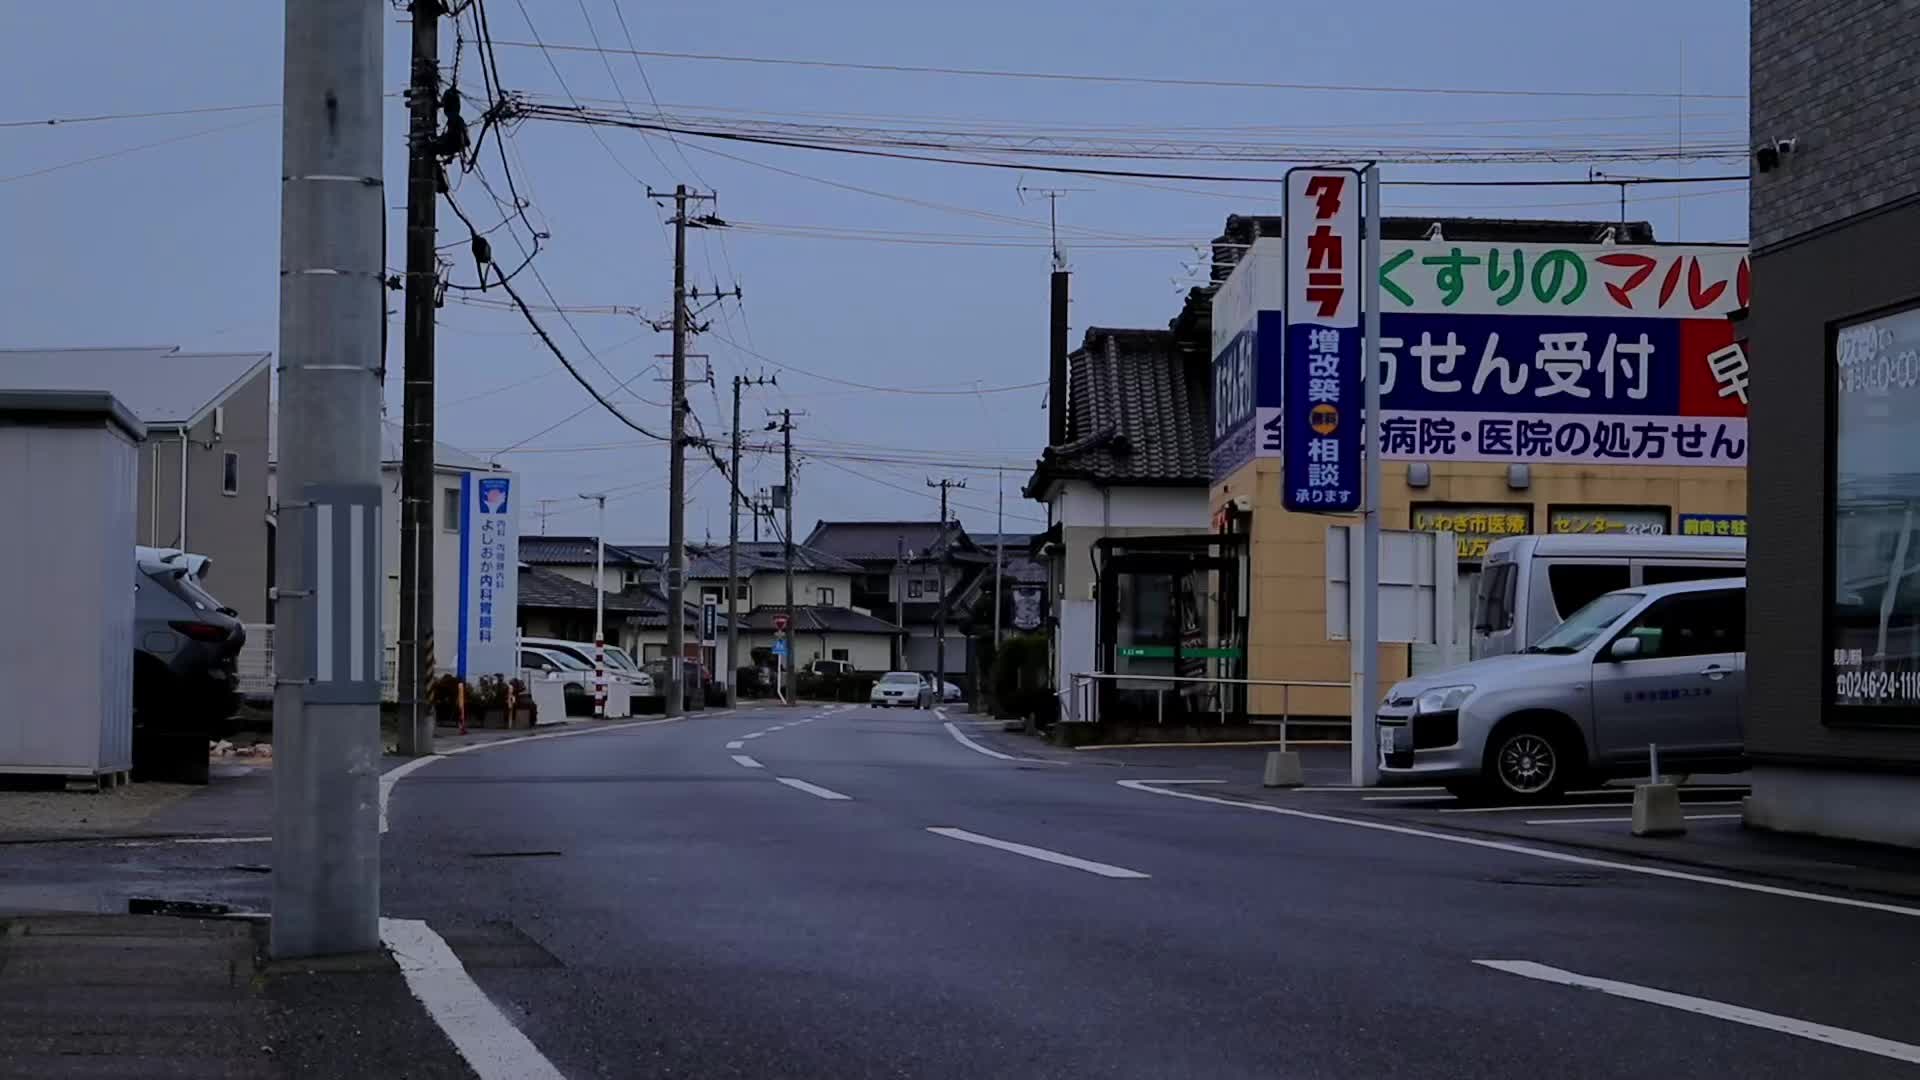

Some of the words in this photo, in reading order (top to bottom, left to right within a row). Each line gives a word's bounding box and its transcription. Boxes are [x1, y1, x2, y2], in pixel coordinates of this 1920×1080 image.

[1305, 176, 1345, 317] タカラ
[1308, 328, 1340, 403] 増改築
[1308, 438, 1340, 487] 相談
[1296, 488, 1351, 503] 承ります
